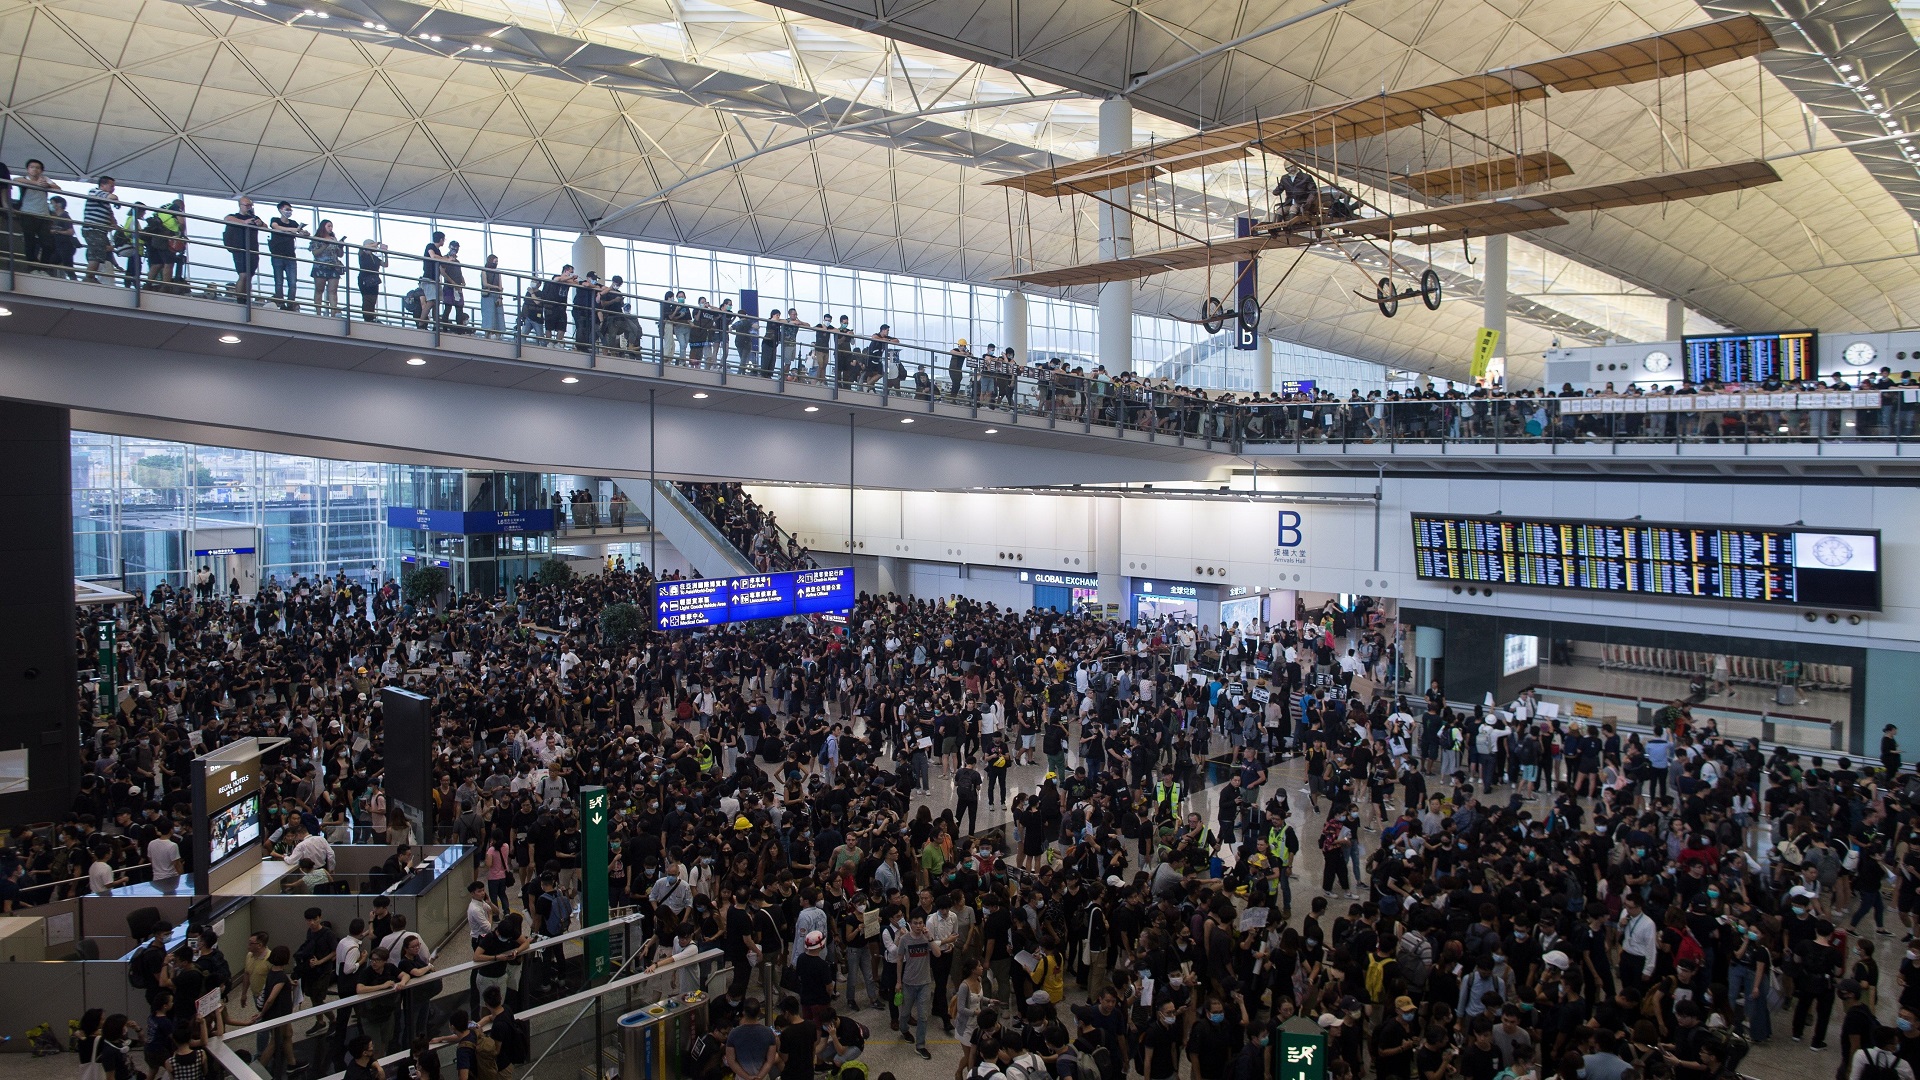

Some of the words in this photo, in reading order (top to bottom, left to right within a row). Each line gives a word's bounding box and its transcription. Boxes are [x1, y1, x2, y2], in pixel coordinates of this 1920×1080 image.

[1242, 328, 1253, 345] B
[1277, 510, 1302, 548] B
[1273, 548, 1307, 558] 接機大堂
[766, 577, 771, 587] 1
[1035, 573, 1065, 584] GLOBAL
[218, 783, 232, 794] REGAL
[232, 774, 249, 787] HOTELS
